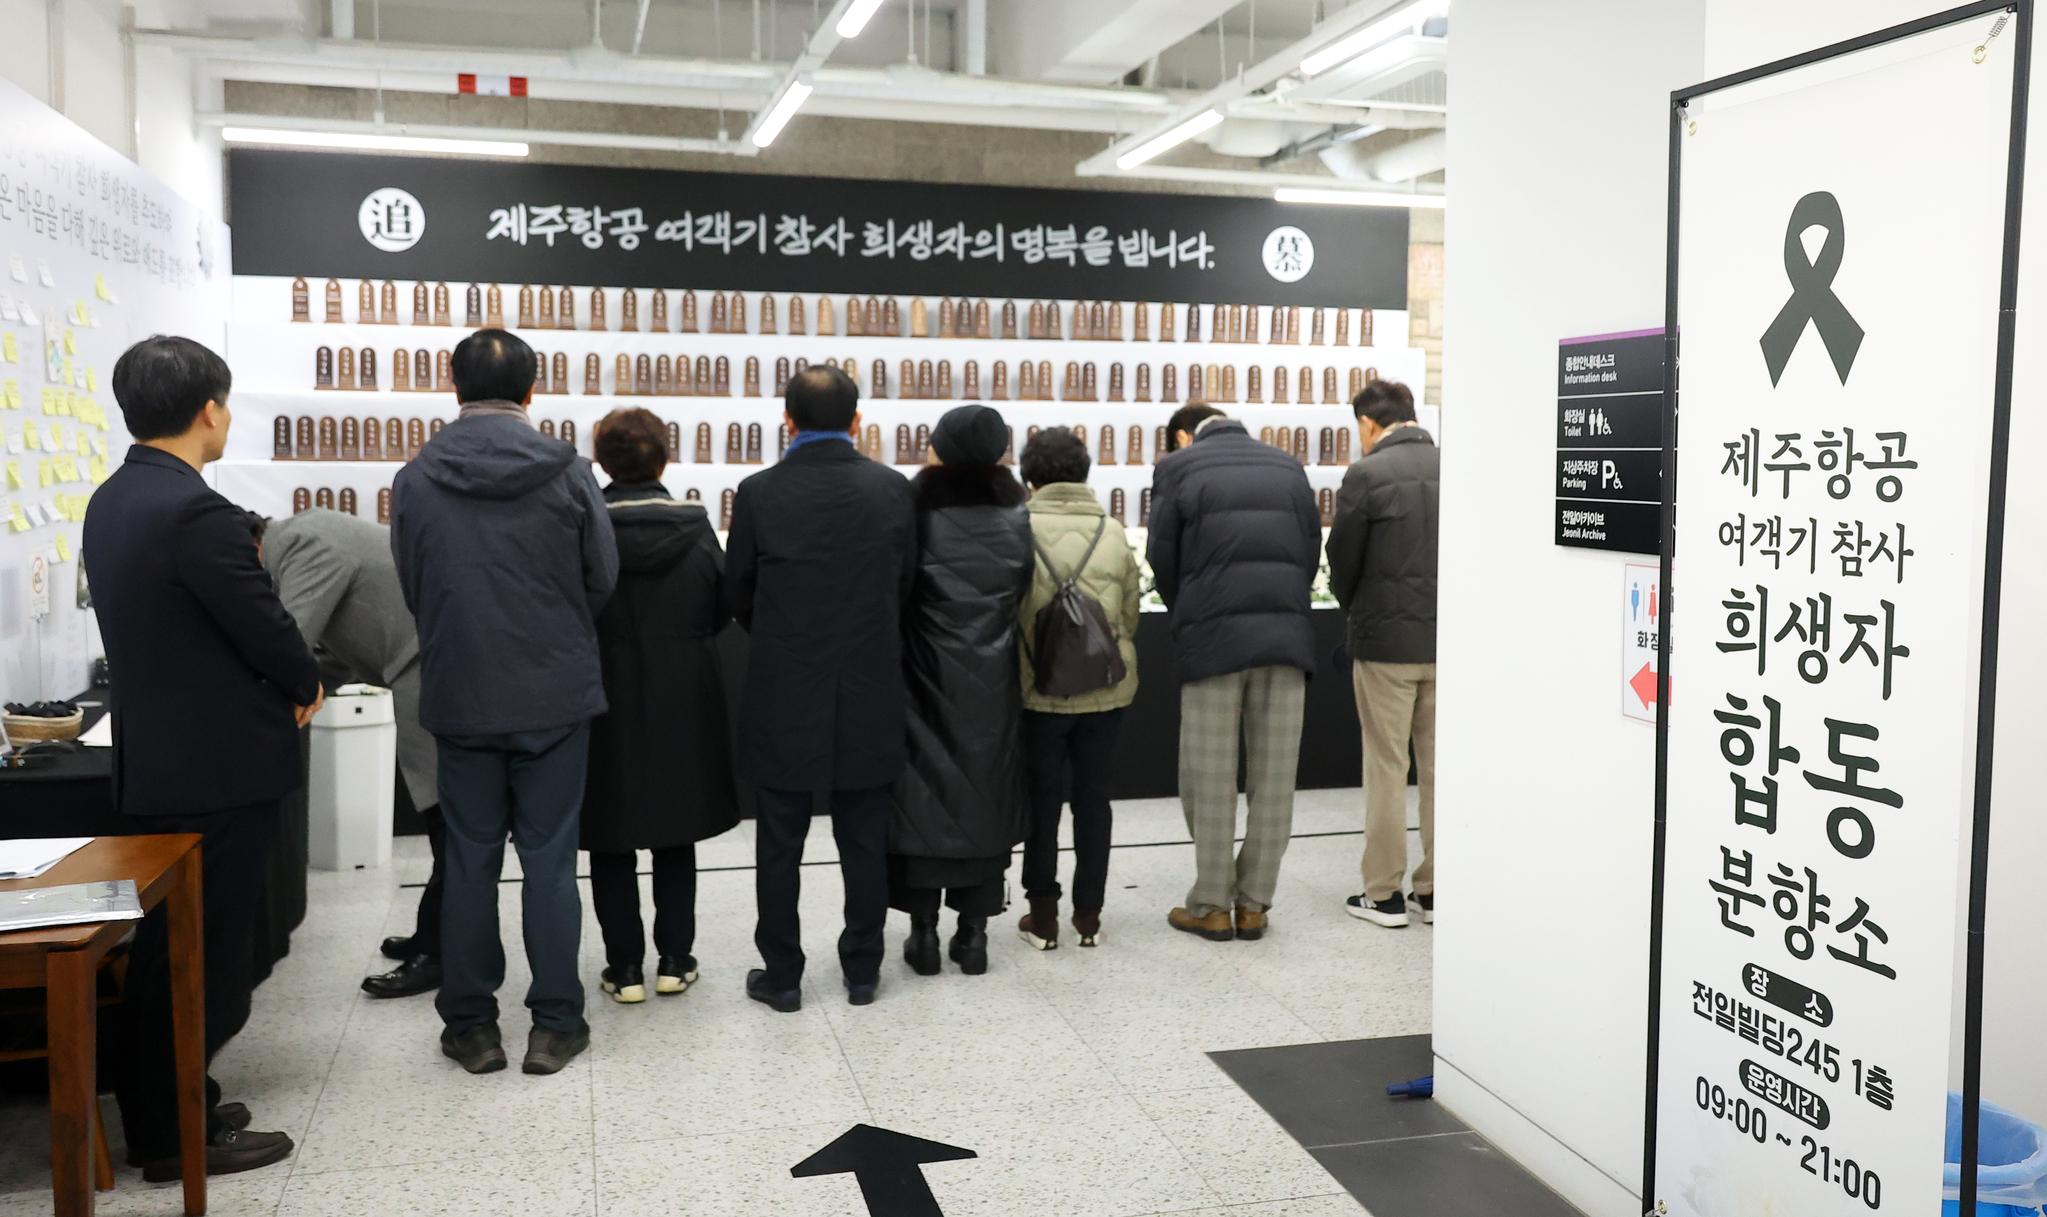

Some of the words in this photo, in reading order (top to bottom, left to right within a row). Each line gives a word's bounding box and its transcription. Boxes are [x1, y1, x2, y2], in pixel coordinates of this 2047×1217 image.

[16, 181, 58, 240] 마음을
[61, 201, 86, 251] 다해
[88, 215, 110, 261] 깊은
[371, 199, 416, 242] 追
[486, 203, 648, 251] 제주항공
[655, 210, 768, 254] 여객기
[774, 214, 855, 257] 참사
[861, 218, 1005, 263] 희생자의
[1010, 224, 1114, 267] 명복을
[1118, 228, 1216, 270] 빕니다.
[1273, 235, 1304, 274] 慕
[1564, 372, 1601, 385] Information
[1601, 371, 1618, 382] desk
[1565, 354, 1616, 372] 종합안내데스크
[1564, 408, 1586, 424] 화장실
[1564, 426, 1582, 437] Toilet
[1562, 460, 1599, 475] 지상주차장
[1562, 477, 1587, 491] Parking
[1602, 460, 1616, 489] P
[1720, 427, 1918, 503] 제주항공
[1562, 526, 1581, 539] Jeonil
[1582, 528, 1607, 541] Archive
[1718, 512, 1817, 575] 여객기
[1831, 519, 1914, 584] 참사
[1715, 584, 1910, 701] 희생자
[1713, 692, 1904, 860] 합동
[1708, 844, 1897, 981] 분향소
[1750, 966, 1770, 998] 장
[1803, 993, 1824, 1024] 소
[1692, 980, 1840, 1083] 전일빌딩245
[1851, 1058, 1895, 1111] 1층
[1747, 1063, 1821, 1125] 운영시간
[1696, 1075, 1767, 1144] 09:00
[1800, 1135, 1881, 1210] 21:00
